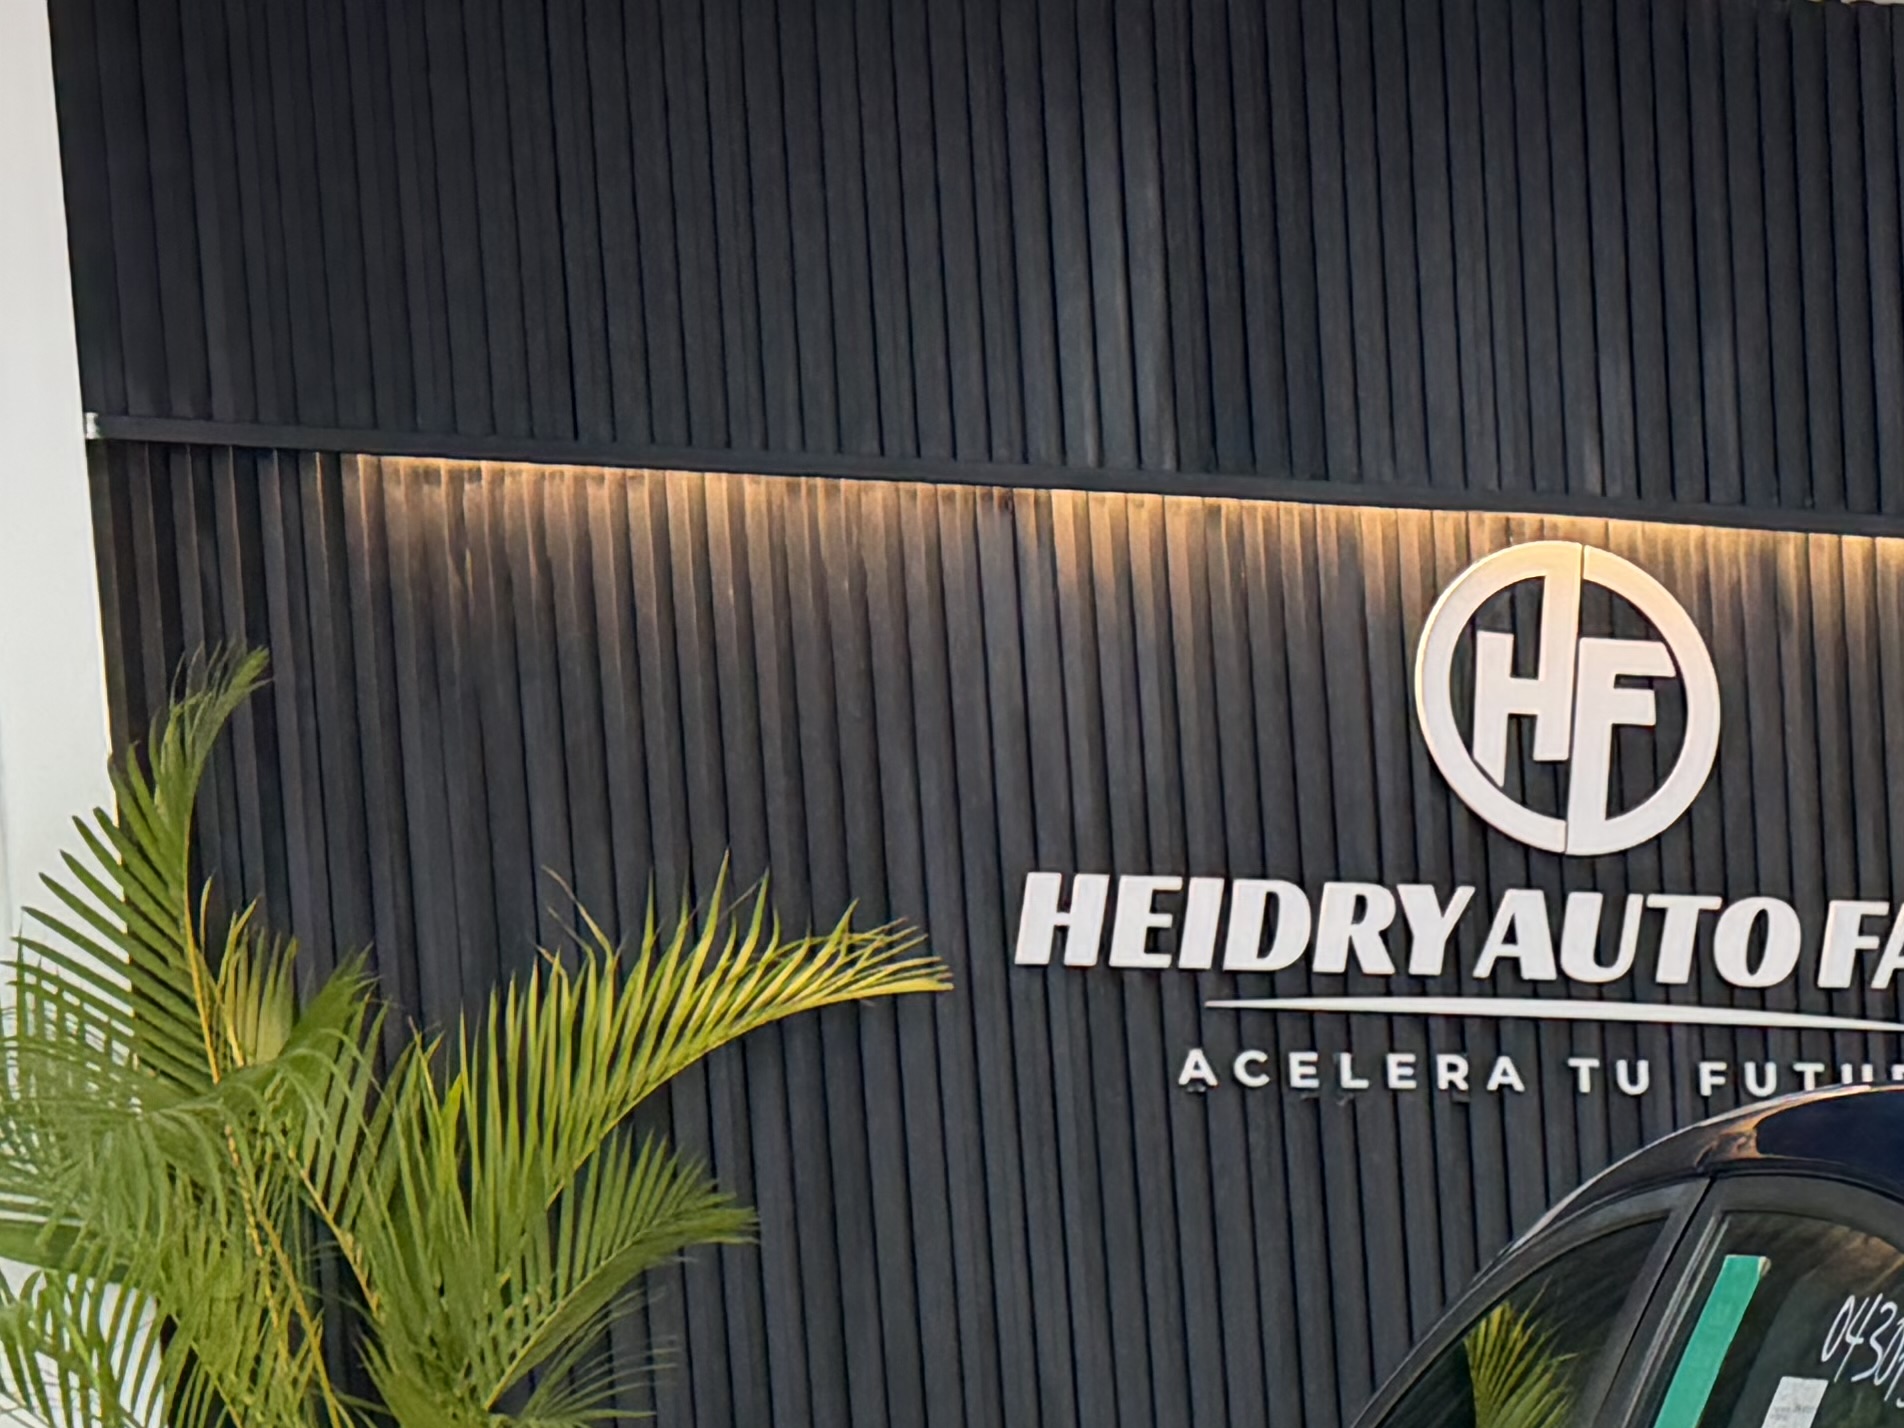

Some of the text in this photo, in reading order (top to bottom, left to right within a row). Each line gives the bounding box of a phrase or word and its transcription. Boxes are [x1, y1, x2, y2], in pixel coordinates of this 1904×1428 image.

[1014, 871, 1476, 976] HEIDRY
[1472, 888, 1801, 988] AUTO
[1178, 1047, 1526, 1092] ACELERA
[1567, 1057, 1650, 1096] TU
